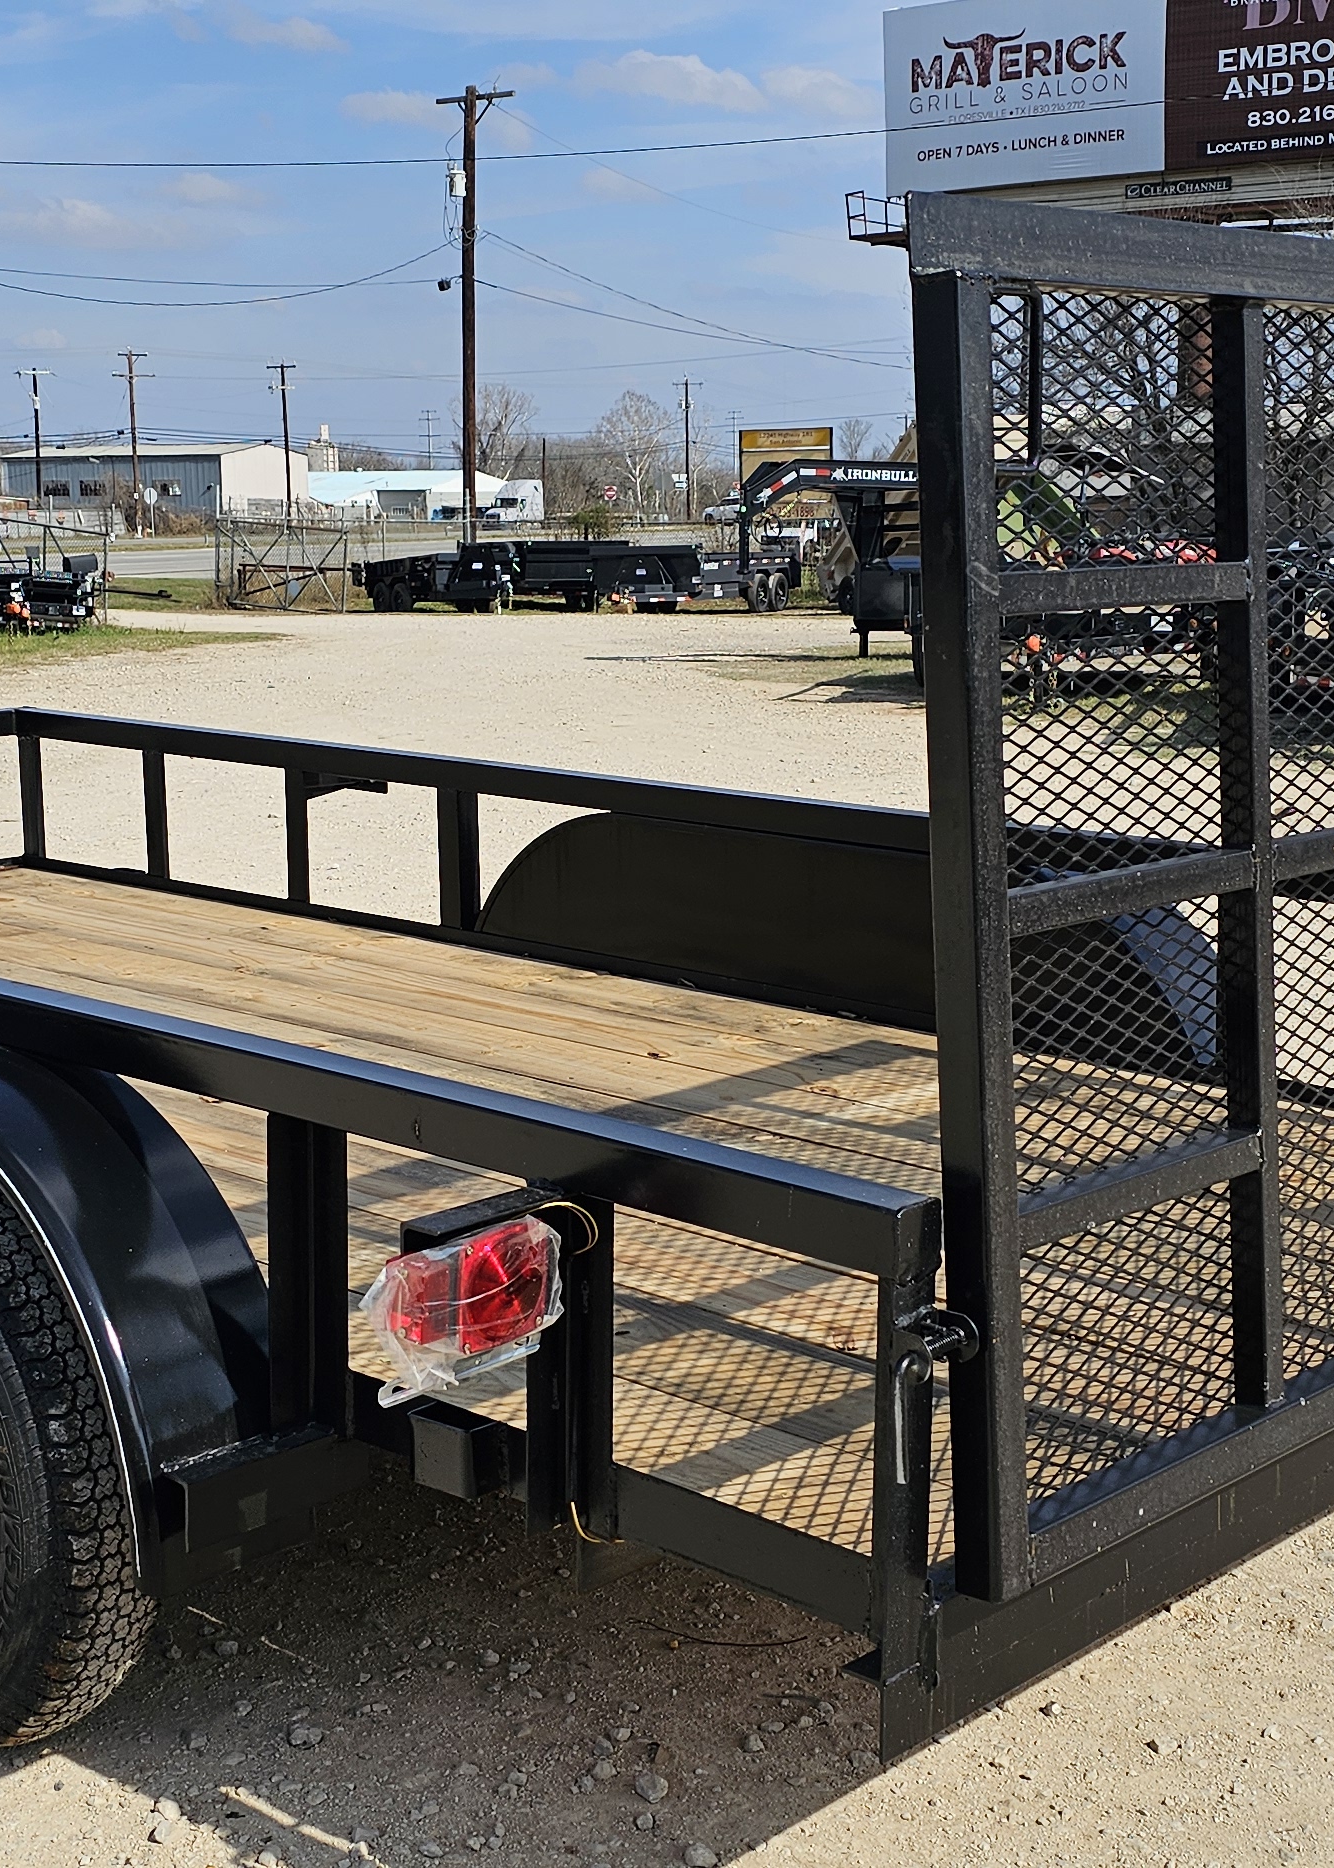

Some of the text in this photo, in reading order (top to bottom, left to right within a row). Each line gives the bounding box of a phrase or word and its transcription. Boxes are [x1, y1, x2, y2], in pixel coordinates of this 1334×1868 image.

[909, 71, 1128, 114] GRILL & SALOON
[1222, 71, 1294, 101] AND
[947, 108, 1007, 125] FLORESVILLE
[917, 128, 1125, 162] OPEN 7 DAYS LUNCH & DINNER
[847, 467, 918, 482] IRONBULL
